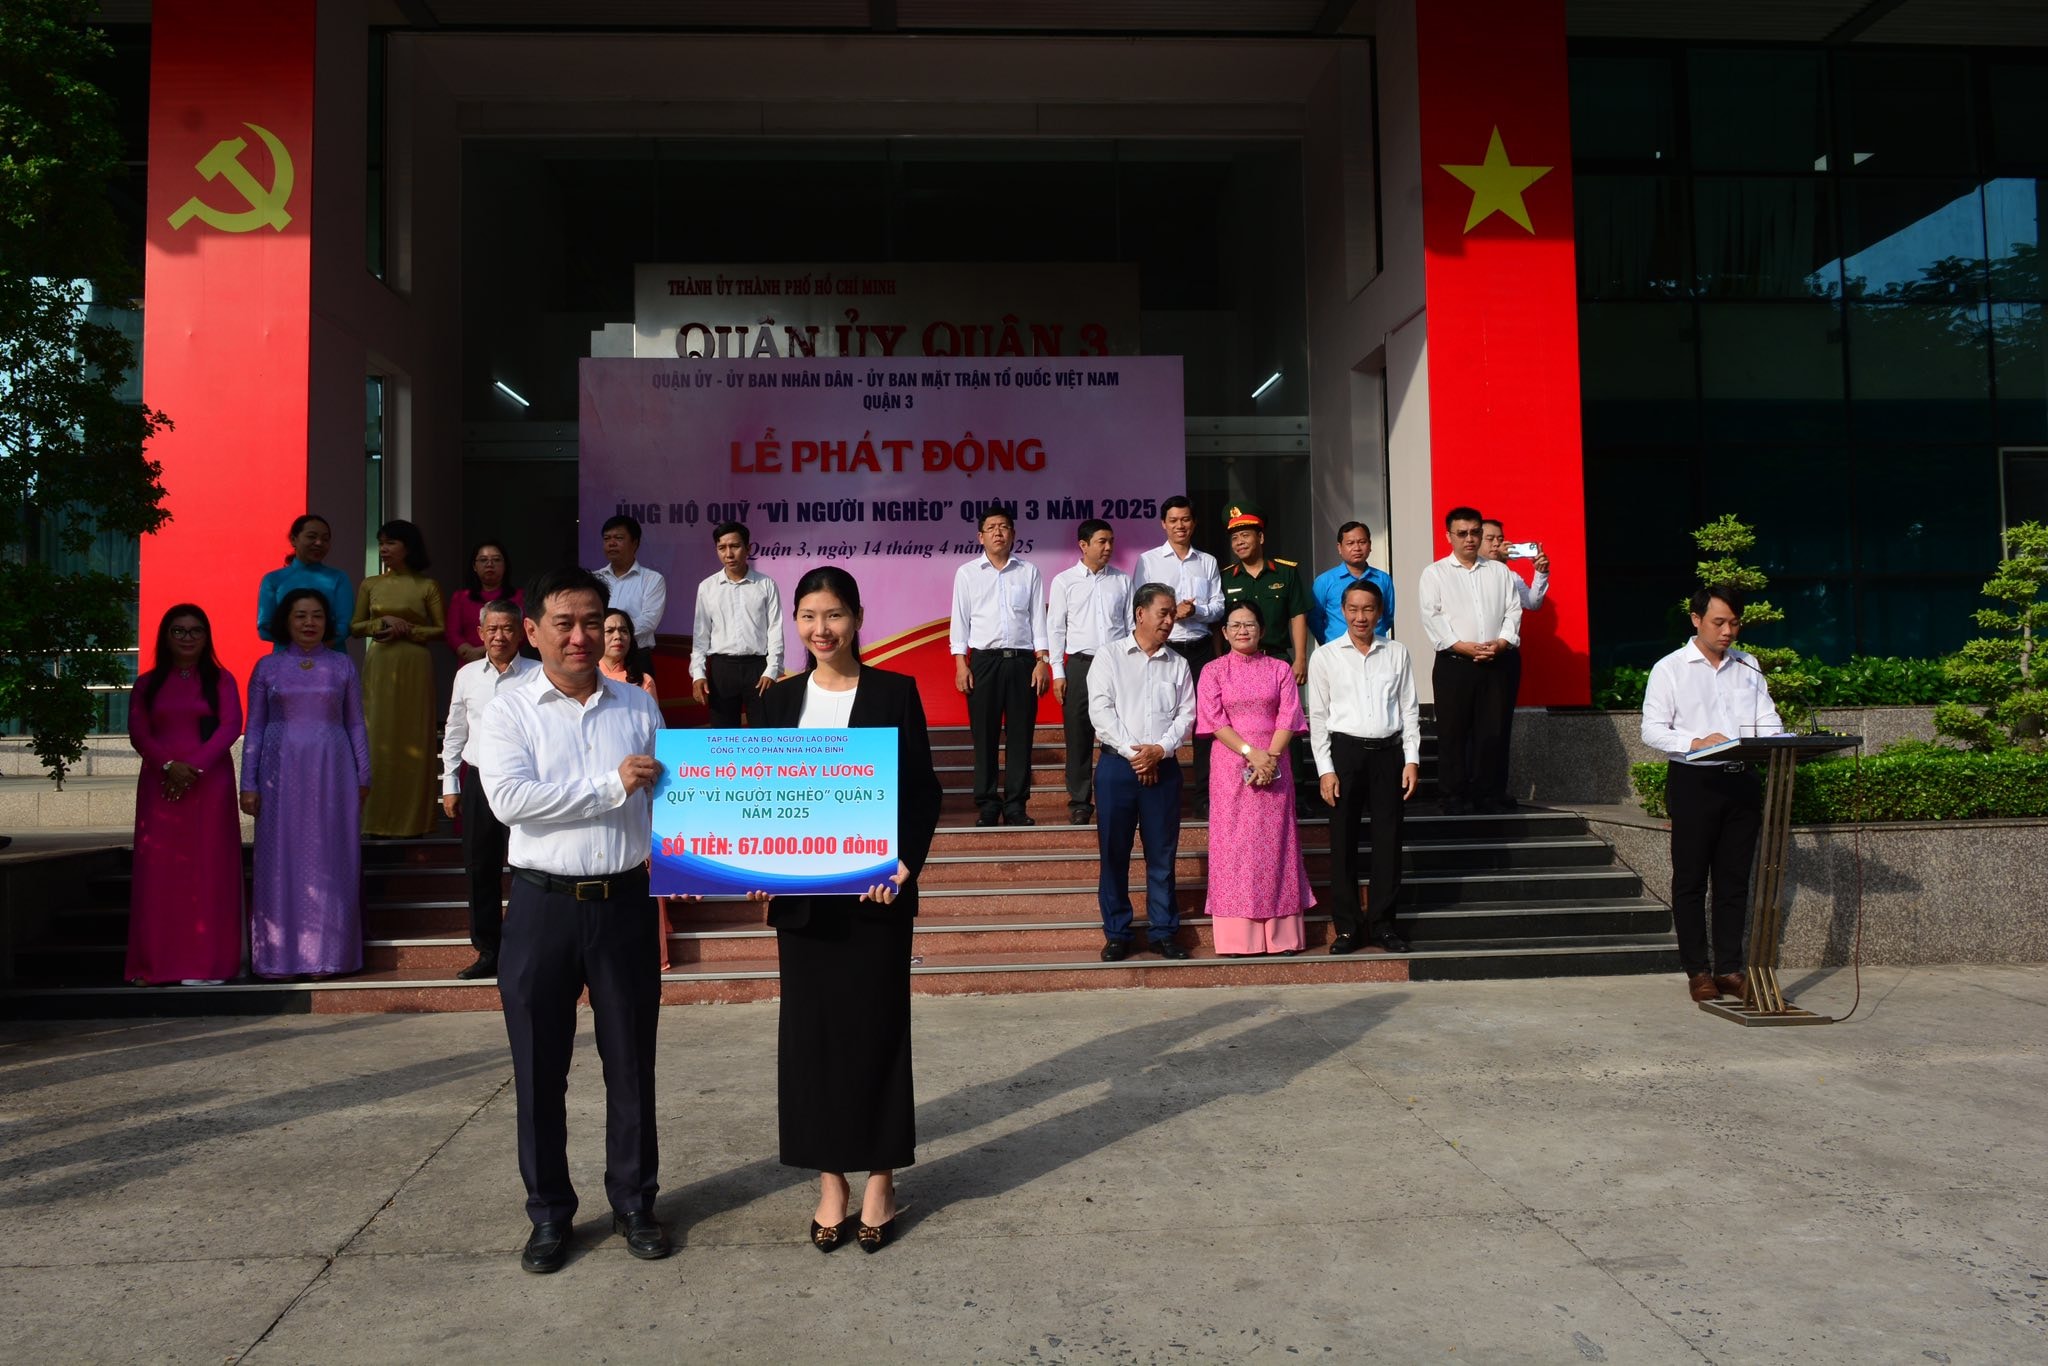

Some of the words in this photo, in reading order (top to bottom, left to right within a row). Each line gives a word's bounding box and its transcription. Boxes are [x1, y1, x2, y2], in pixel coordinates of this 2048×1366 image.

[668, 276, 713, 296] THÀNH
[717, 274, 734, 296] ỦY
[736, 276, 781, 296] THÀNH
[785, 273, 812, 296] PHỐ
[836, 275, 859, 296] CHÍ
[862, 279, 897, 296] MINH
[1079, 323, 1109, 357] 3
[652, 370, 691, 391] QUẬN
[694, 369, 713, 388] ỦY
[726, 369, 744, 388] ỦY
[749, 373, 778, 388] BAN
[781, 370, 821, 388] NHÂN
[824, 370, 854, 388] DÂN
[867, 369, 885, 387] ỦY
[888, 373, 917, 387] BAN
[921, 368, 951, 390] MẶT
[954, 368, 991, 390] TRẬN
[994, 366, 1011, 387] TỔ
[1015, 366, 1052, 388] QUỐC
[1055, 368, 1084, 390] VIỆT
[1087, 371, 1120, 387] NAM
[862, 391, 901, 412] QUẬN
[904, 394, 914, 409] 3
[730, 426, 782, 473] LỄ
[791, 429, 914, 473] PHÁT
[922, 432, 1047, 480] ĐỘNG
[668, 500, 699, 528] HỘ
[706, 499, 751, 525] QUỸ
[796, 497, 865, 523] NGƯỜI
[1025, 499, 1040, 521] 3
[1046, 495, 1095, 521] NĂM
[1101, 498, 1157, 521] 2025
[748, 541, 792, 561] Quận
[796, 541, 812, 560] 3,
[817, 542, 857, 560] ngày
[863, 541, 883, 556] 14
[886, 539, 934, 558] tháng
[938, 540, 949, 556] 4
[737, 746, 747, 754] TY
[806, 735, 823, 743] LAO
[715, 761, 737, 780] HỘ
[741, 761, 773, 780] MỘT
[777, 761, 818, 777] NGÀY
[822, 763, 875, 777] LƯƠNG
[666, 787, 696, 805] QUỸ
[725, 786, 772, 802] NGƯỜI
[834, 786, 873, 804] QUẬN
[876, 789, 885, 801] 3
[742, 804, 772, 819] NĂM
[777, 807, 810, 819] 2025
[661, 832, 685, 857] SỐ
[690, 831, 733, 856] TIỀN:
[738, 836, 837, 856] 67.000.000
[843, 833, 889, 857] đồng
